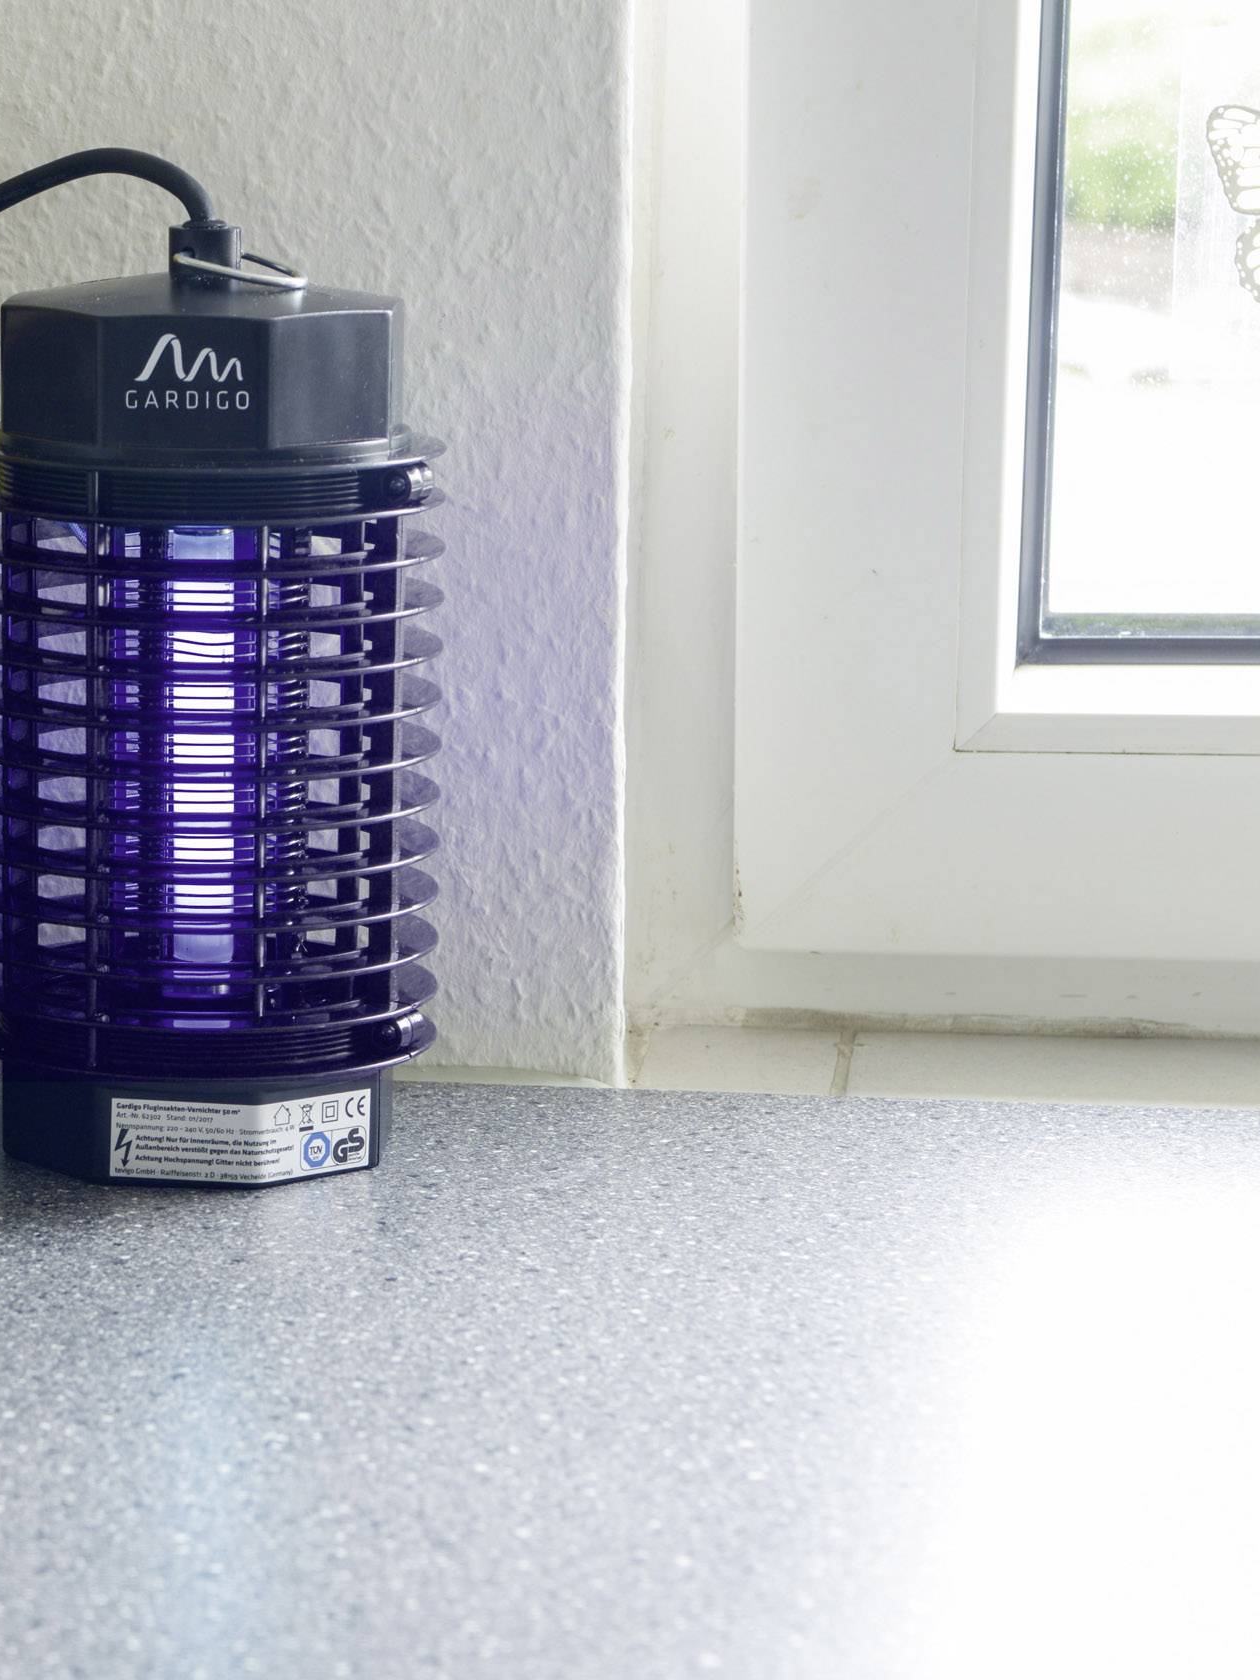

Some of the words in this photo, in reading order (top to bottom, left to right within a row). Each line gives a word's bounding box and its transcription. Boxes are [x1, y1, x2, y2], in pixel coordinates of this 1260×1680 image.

[125, 389, 250, 410] GARDIGO
[116, 1102, 142, 1112] Gardigo
[143, 1103, 221, 1114] Fluginsekten-Vernichter
[135, 1134, 165, 1144] Achtung!
[179, 1136, 189, 1144] für
[243, 1140, 269, 1148] Nutzung
[333, 1128, 365, 1163] GS
[135, 1144, 180, 1153] Außenbereich
[209, 1148, 229, 1156] gegen
[229, 1148, 242, 1156] das
[309, 1145, 323, 1156] TÜV
[134, 1154, 163, 1164] Achtung
[163, 1156, 214, 1166] Hochspannung!
[215, 1158, 235, 1166] Gitter
[235, 1159, 252, 1167] nicht
[115, 1167, 135, 1176] tevigo
[135, 1167, 156, 1176] GmbH
